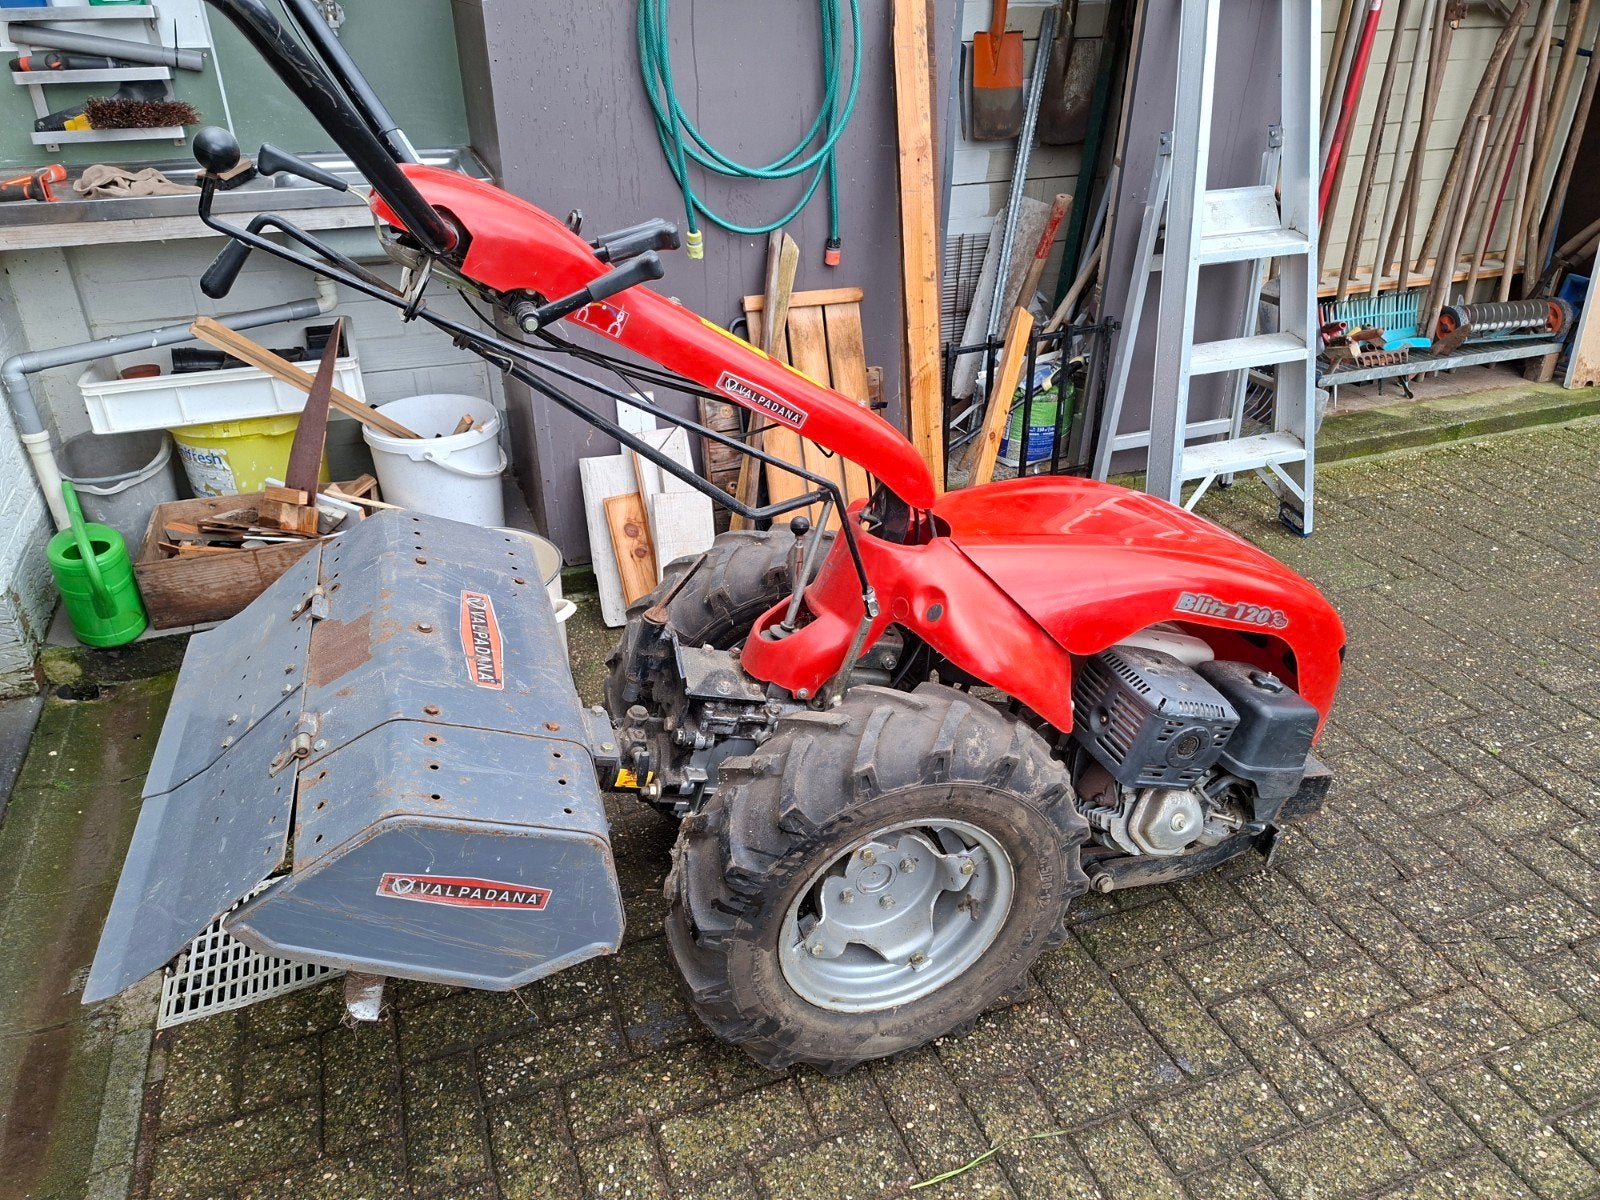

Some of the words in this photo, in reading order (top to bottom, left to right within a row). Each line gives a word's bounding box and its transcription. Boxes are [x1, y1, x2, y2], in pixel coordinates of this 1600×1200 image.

[739, 385, 800, 423] VALPADANA
[1177, 592, 1230, 617] Blitz
[1234, 603, 1272, 624] 120
[470, 611, 495, 681] VALPADANA
[420, 882, 541, 905] VALPADANA
